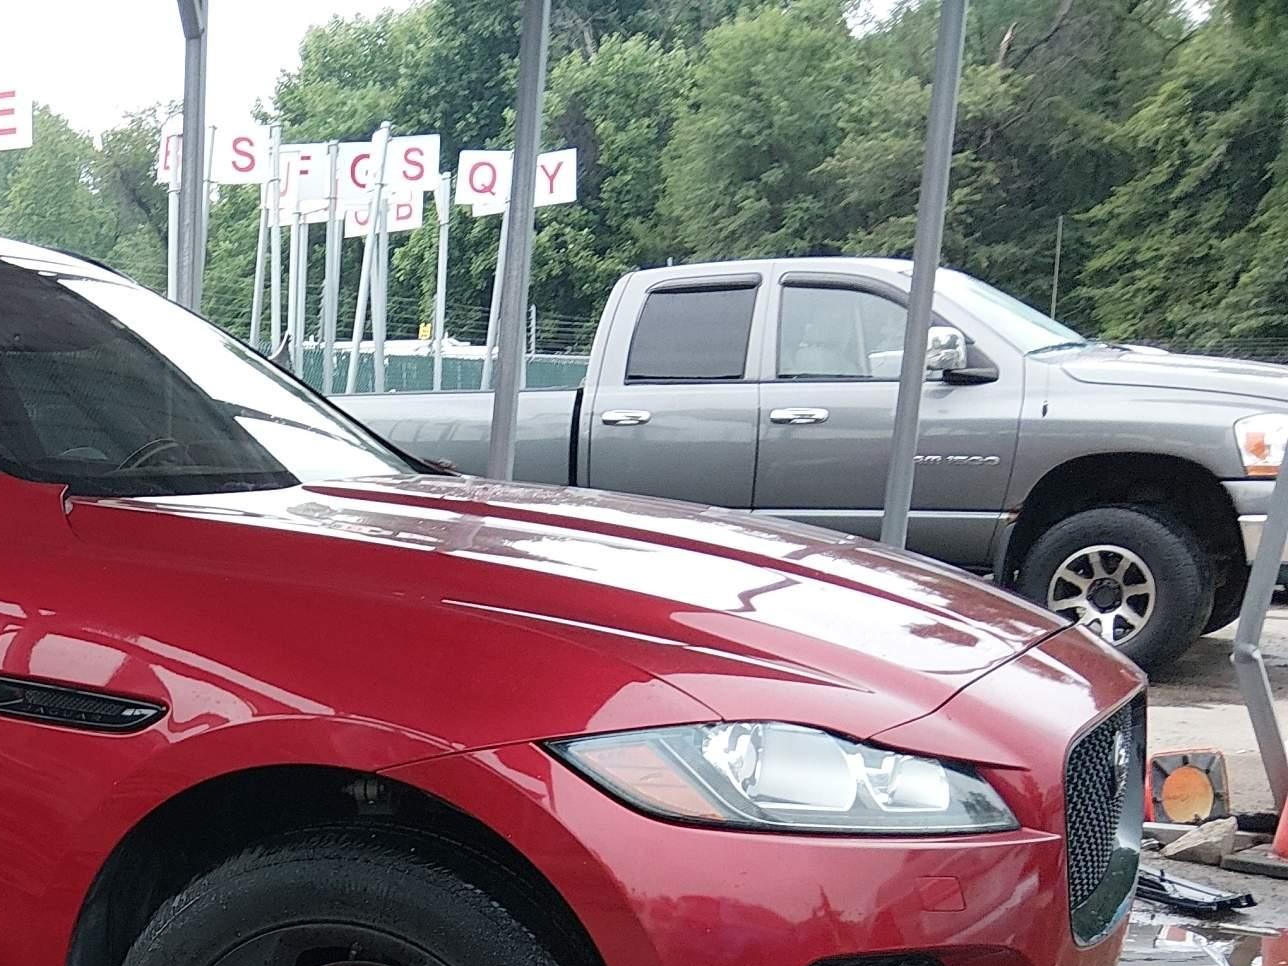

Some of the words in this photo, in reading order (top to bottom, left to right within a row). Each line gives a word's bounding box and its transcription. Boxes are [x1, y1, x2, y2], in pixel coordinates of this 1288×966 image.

[231, 136, 256, 173] S
[402, 147, 425, 181] S
[468, 161, 497, 195] Q
[540, 161, 564, 194] Y
[946, 455, 1001, 466] 1500
